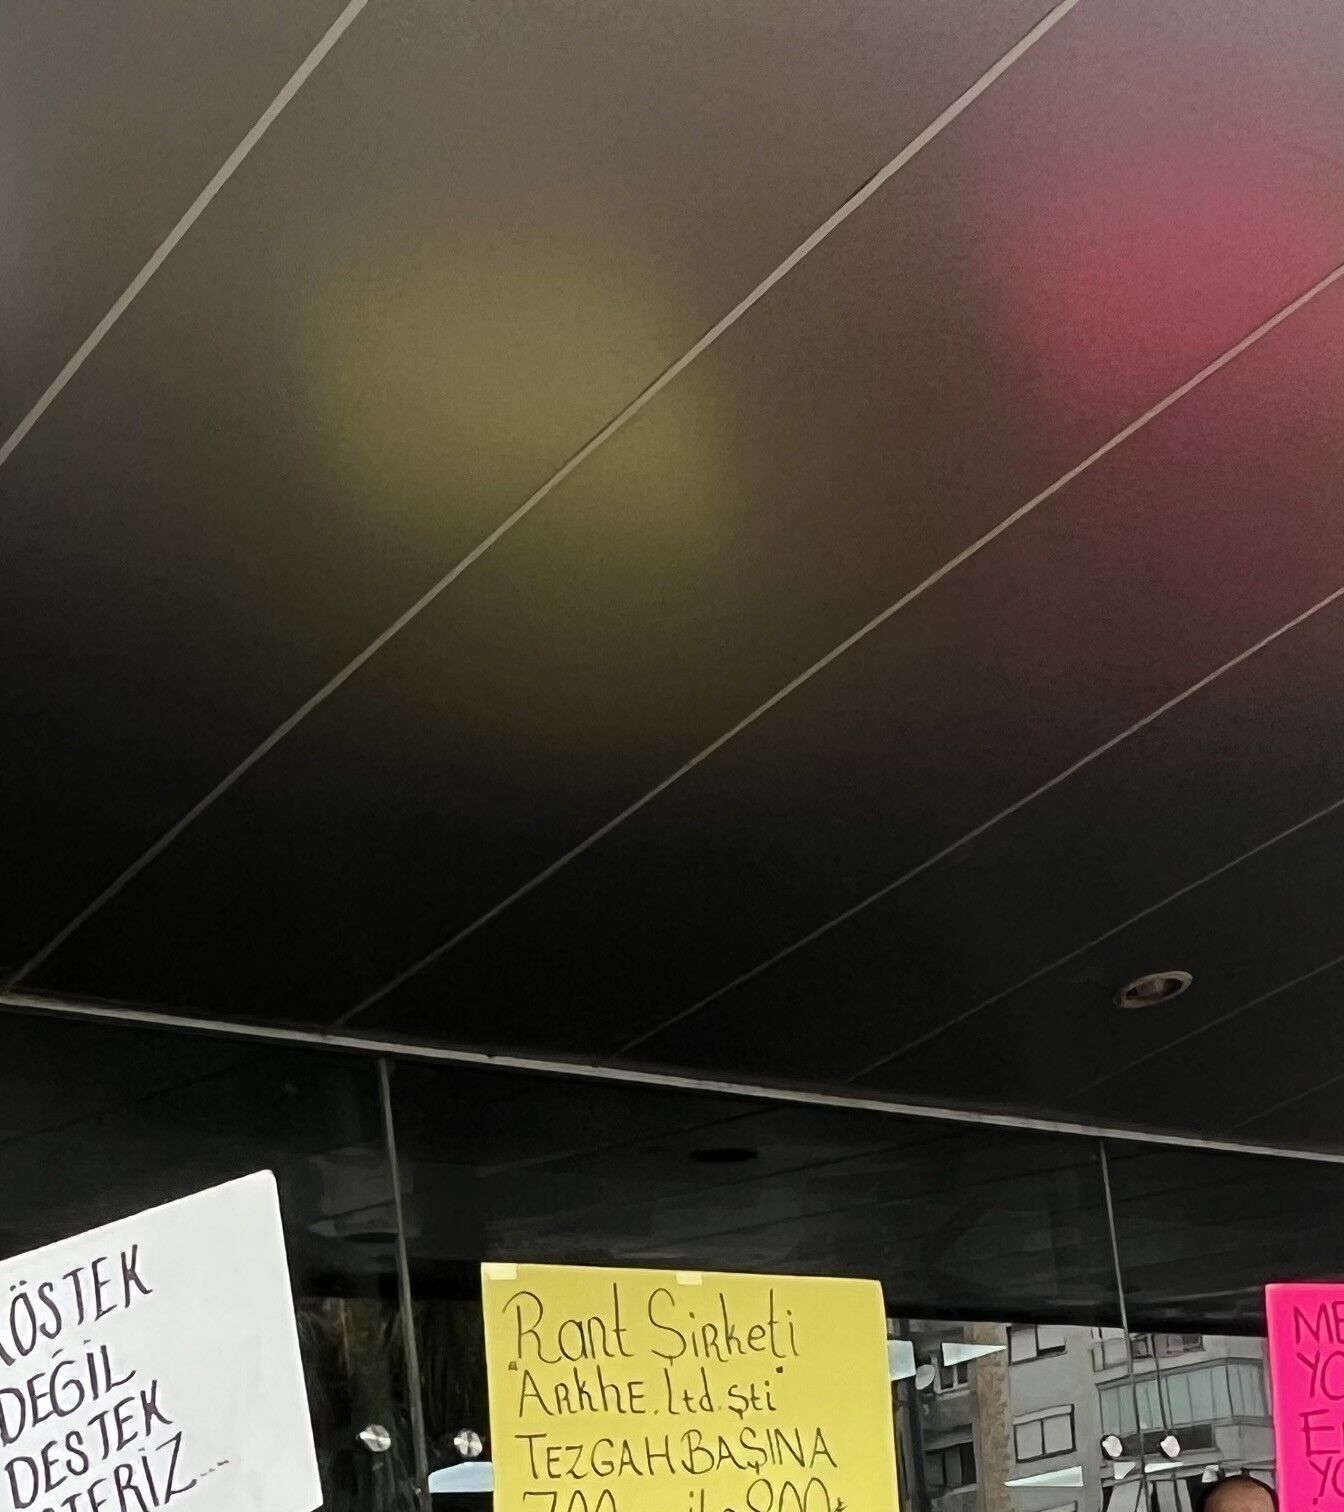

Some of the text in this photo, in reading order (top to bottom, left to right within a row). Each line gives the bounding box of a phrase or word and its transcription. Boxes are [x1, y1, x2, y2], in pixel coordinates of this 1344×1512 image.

[502, 1283, 634, 1364] Rant
[4, 1380, 173, 1510] DESTEK
[514, 1426, 837, 1480] TEZGAH BAŞINA
